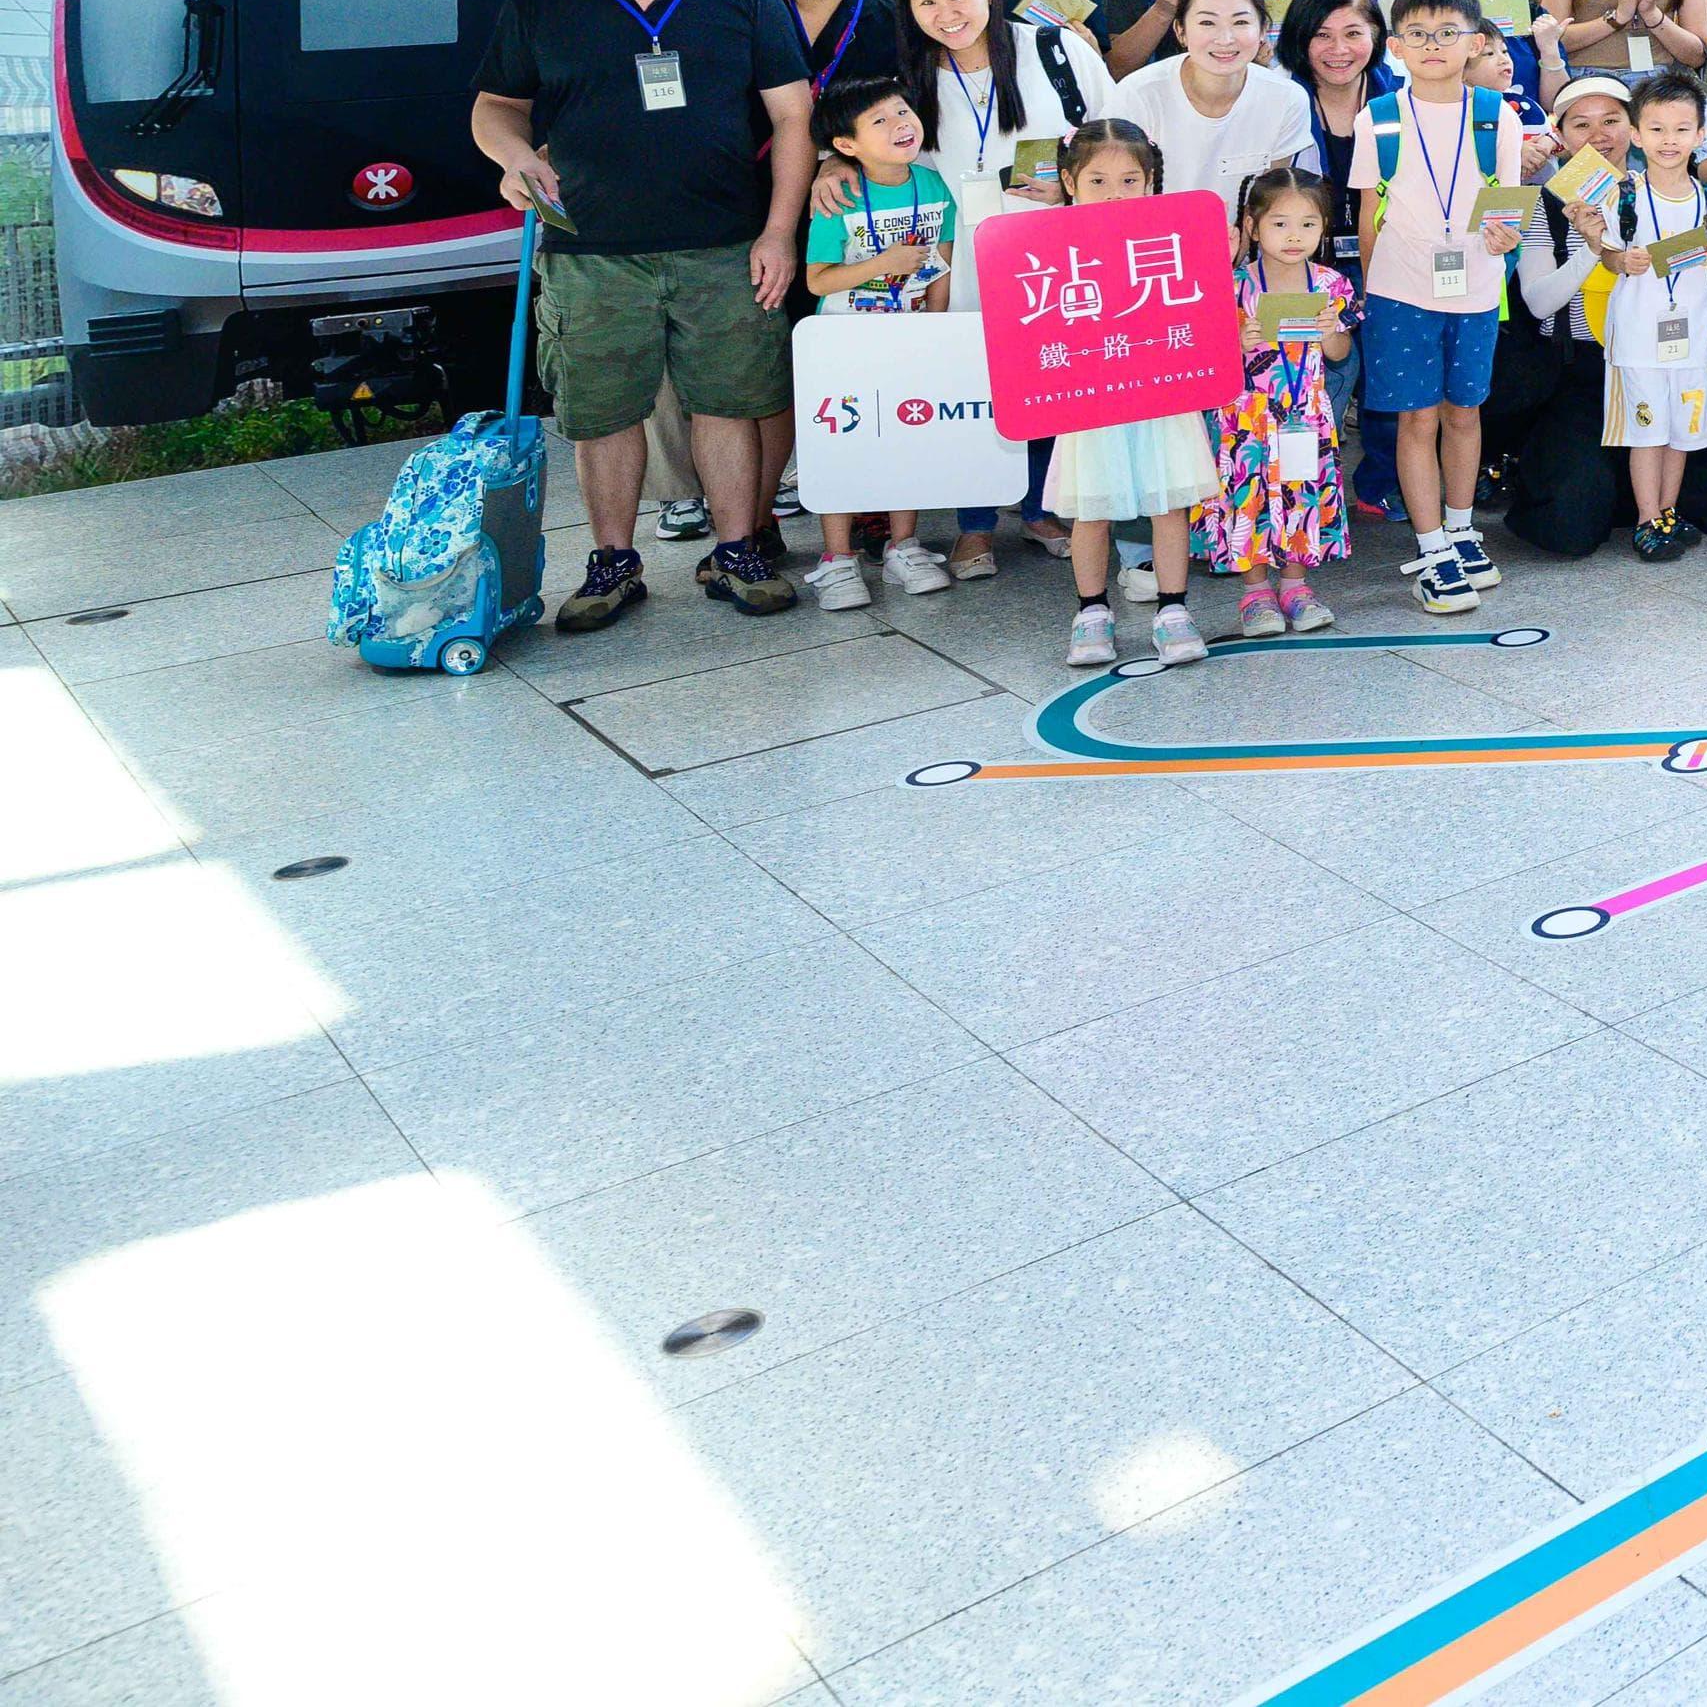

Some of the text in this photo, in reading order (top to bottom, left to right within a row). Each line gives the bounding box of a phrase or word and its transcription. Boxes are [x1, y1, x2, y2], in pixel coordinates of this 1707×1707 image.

[654, 86, 675, 97] 116
[1014, 232, 1205, 326] 站見
[1025, 367, 1216, 406] STATION RAIL VOYAGE
[1681, 389, 1705, 434] 7
